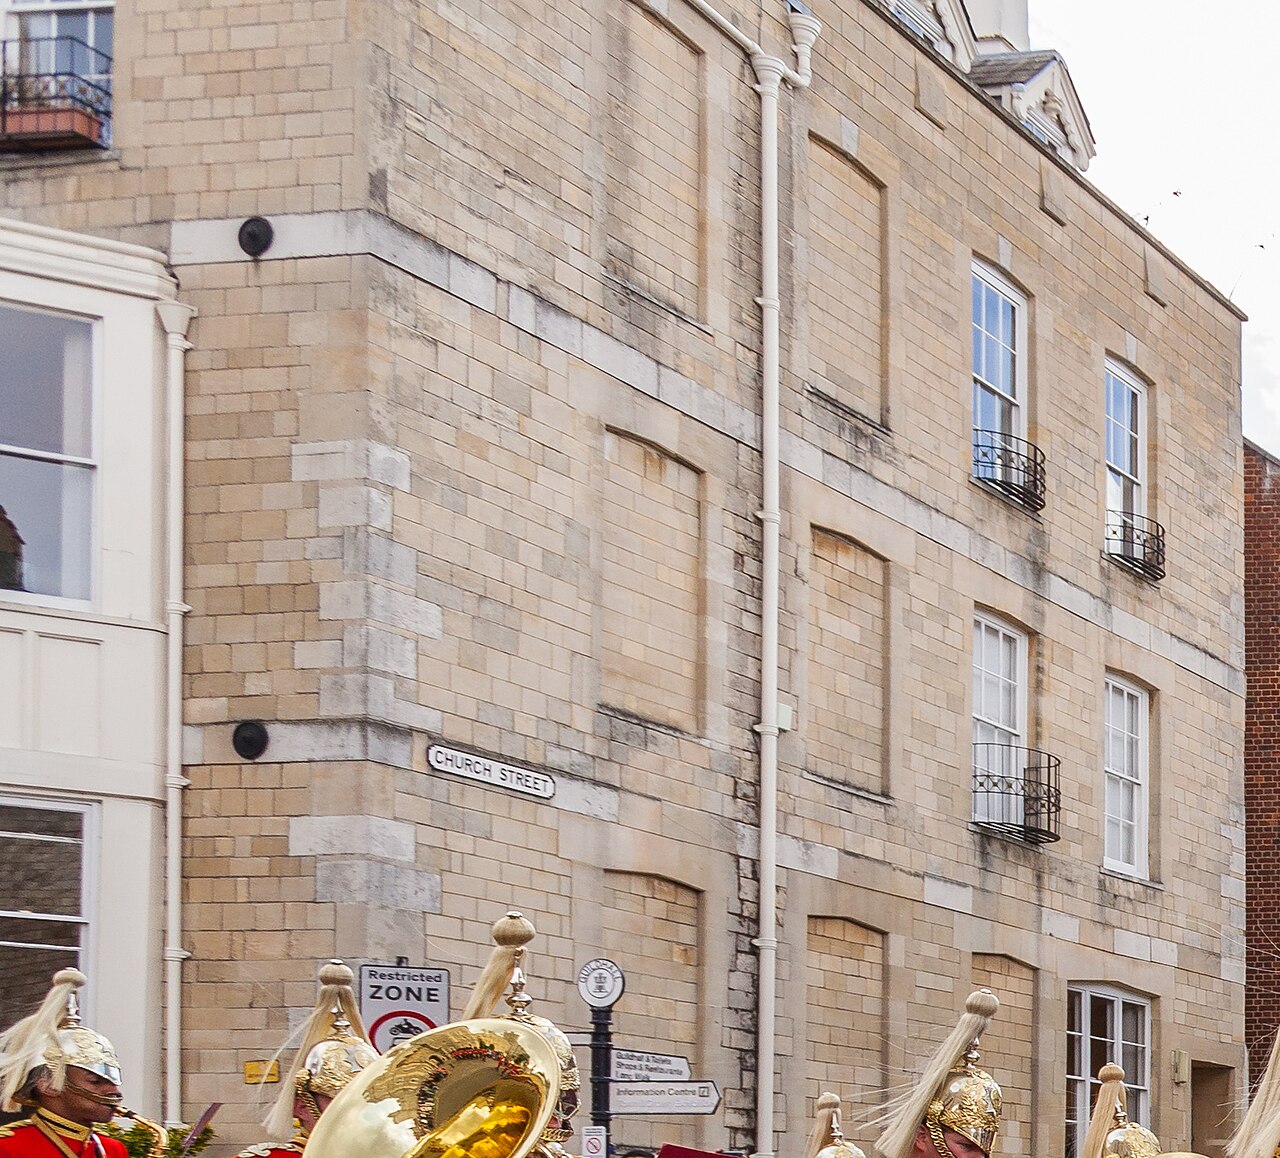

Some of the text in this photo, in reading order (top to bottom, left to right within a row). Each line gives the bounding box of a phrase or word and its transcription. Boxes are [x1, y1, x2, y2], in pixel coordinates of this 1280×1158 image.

[436, 750, 549, 792] CHURCH STREET
[368, 969, 442, 983] Restricted
[369, 984, 440, 1003] ZONE
[616, 1087, 697, 1097] Information Centre
